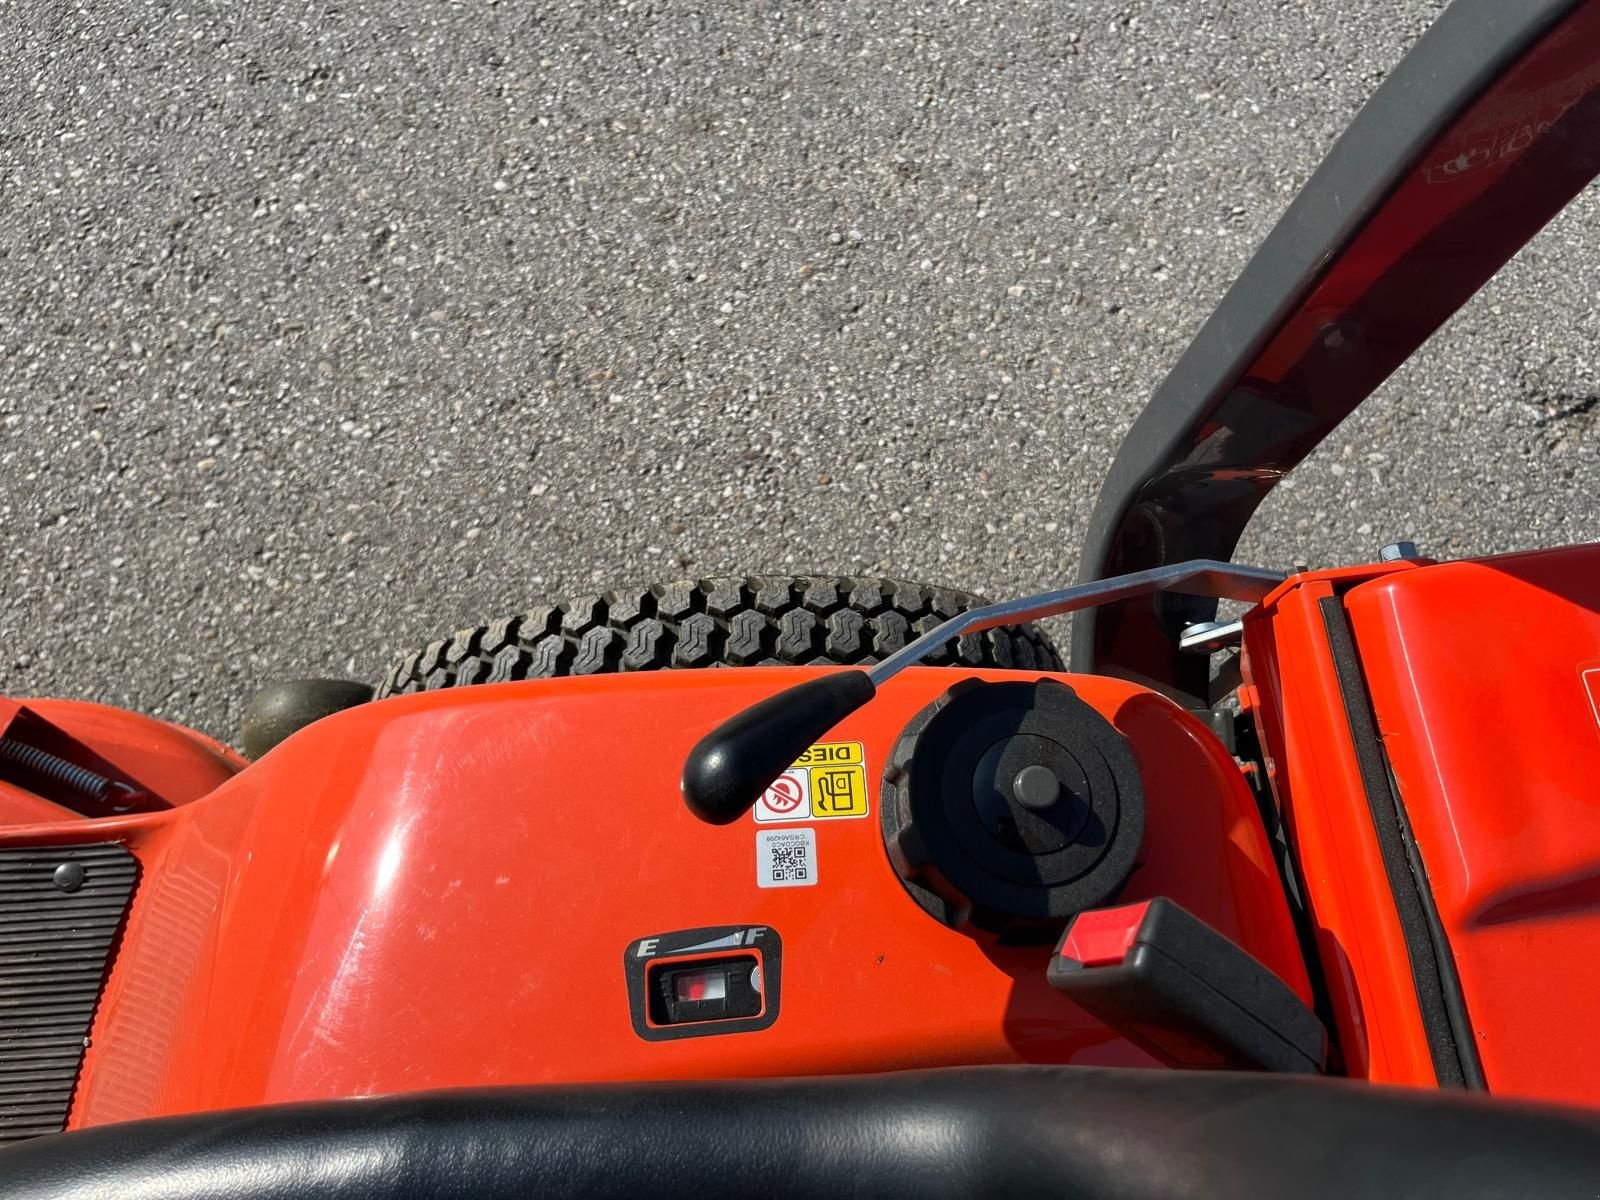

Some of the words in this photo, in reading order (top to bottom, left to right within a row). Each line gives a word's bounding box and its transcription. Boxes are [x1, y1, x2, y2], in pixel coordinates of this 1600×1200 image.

[798, 746, 851, 763] DIES
[836, 777, 846, 789] D
[637, 938, 660, 957] E
[745, 927, 768, 945] F
